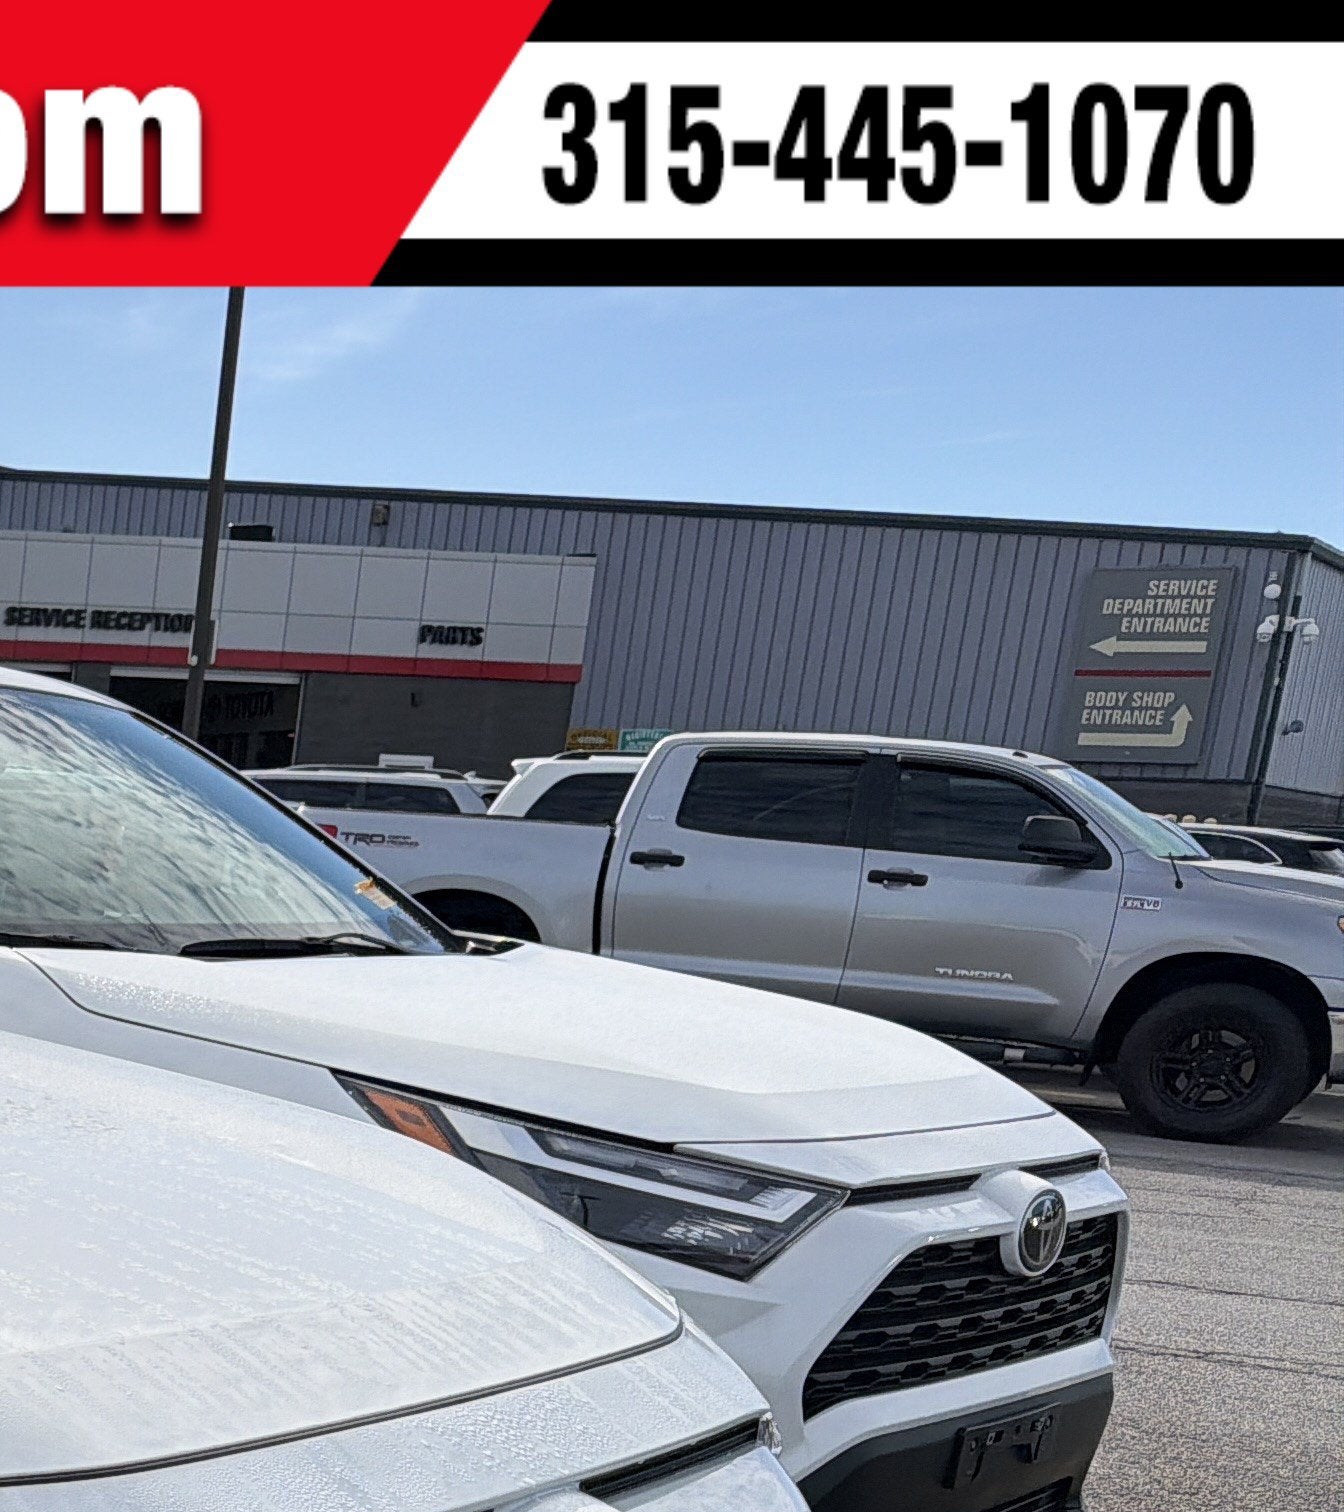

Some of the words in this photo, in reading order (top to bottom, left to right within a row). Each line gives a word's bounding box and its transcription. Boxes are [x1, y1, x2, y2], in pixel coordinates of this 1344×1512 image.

[1147, 579, 1219, 596] SERVICE
[1102, 598, 1215, 615] DEPARTMENT
[3, 606, 87, 629] SERVICE
[1120, 616, 1211, 633] ENTRANCE
[418, 624, 485, 646] PARTS
[1084, 691, 1128, 707] BODY
[1131, 692, 1175, 708] SHOP
[1081, 709, 1165, 726] ENTRANCE
[934, 966, 1014, 982] TUNDRA
